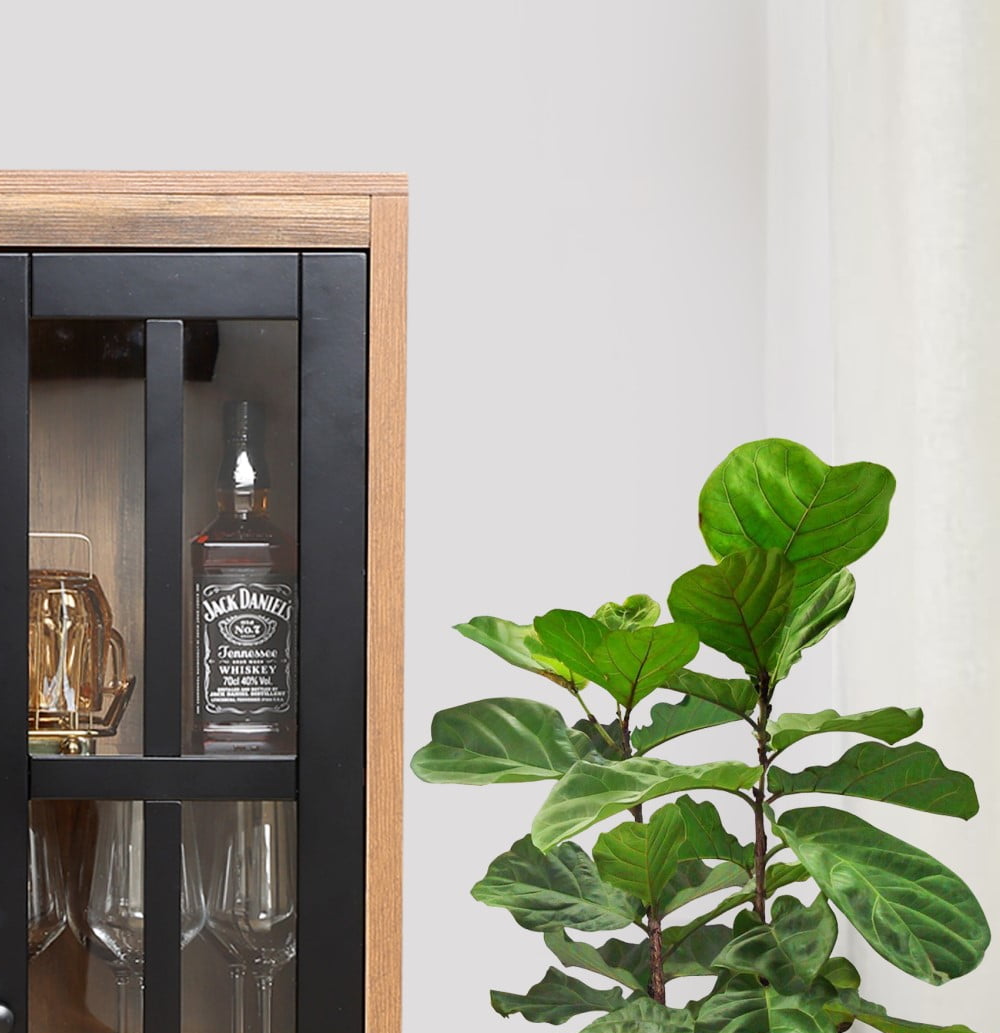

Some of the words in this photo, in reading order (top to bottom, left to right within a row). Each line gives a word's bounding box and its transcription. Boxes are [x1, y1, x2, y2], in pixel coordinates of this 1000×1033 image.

[202, 594, 239, 622] JACK
[239, 587, 292, 621] DANIEL'S
[217, 645, 278, 659] Tennessee
[219, 665, 277, 675] WHISKEY
